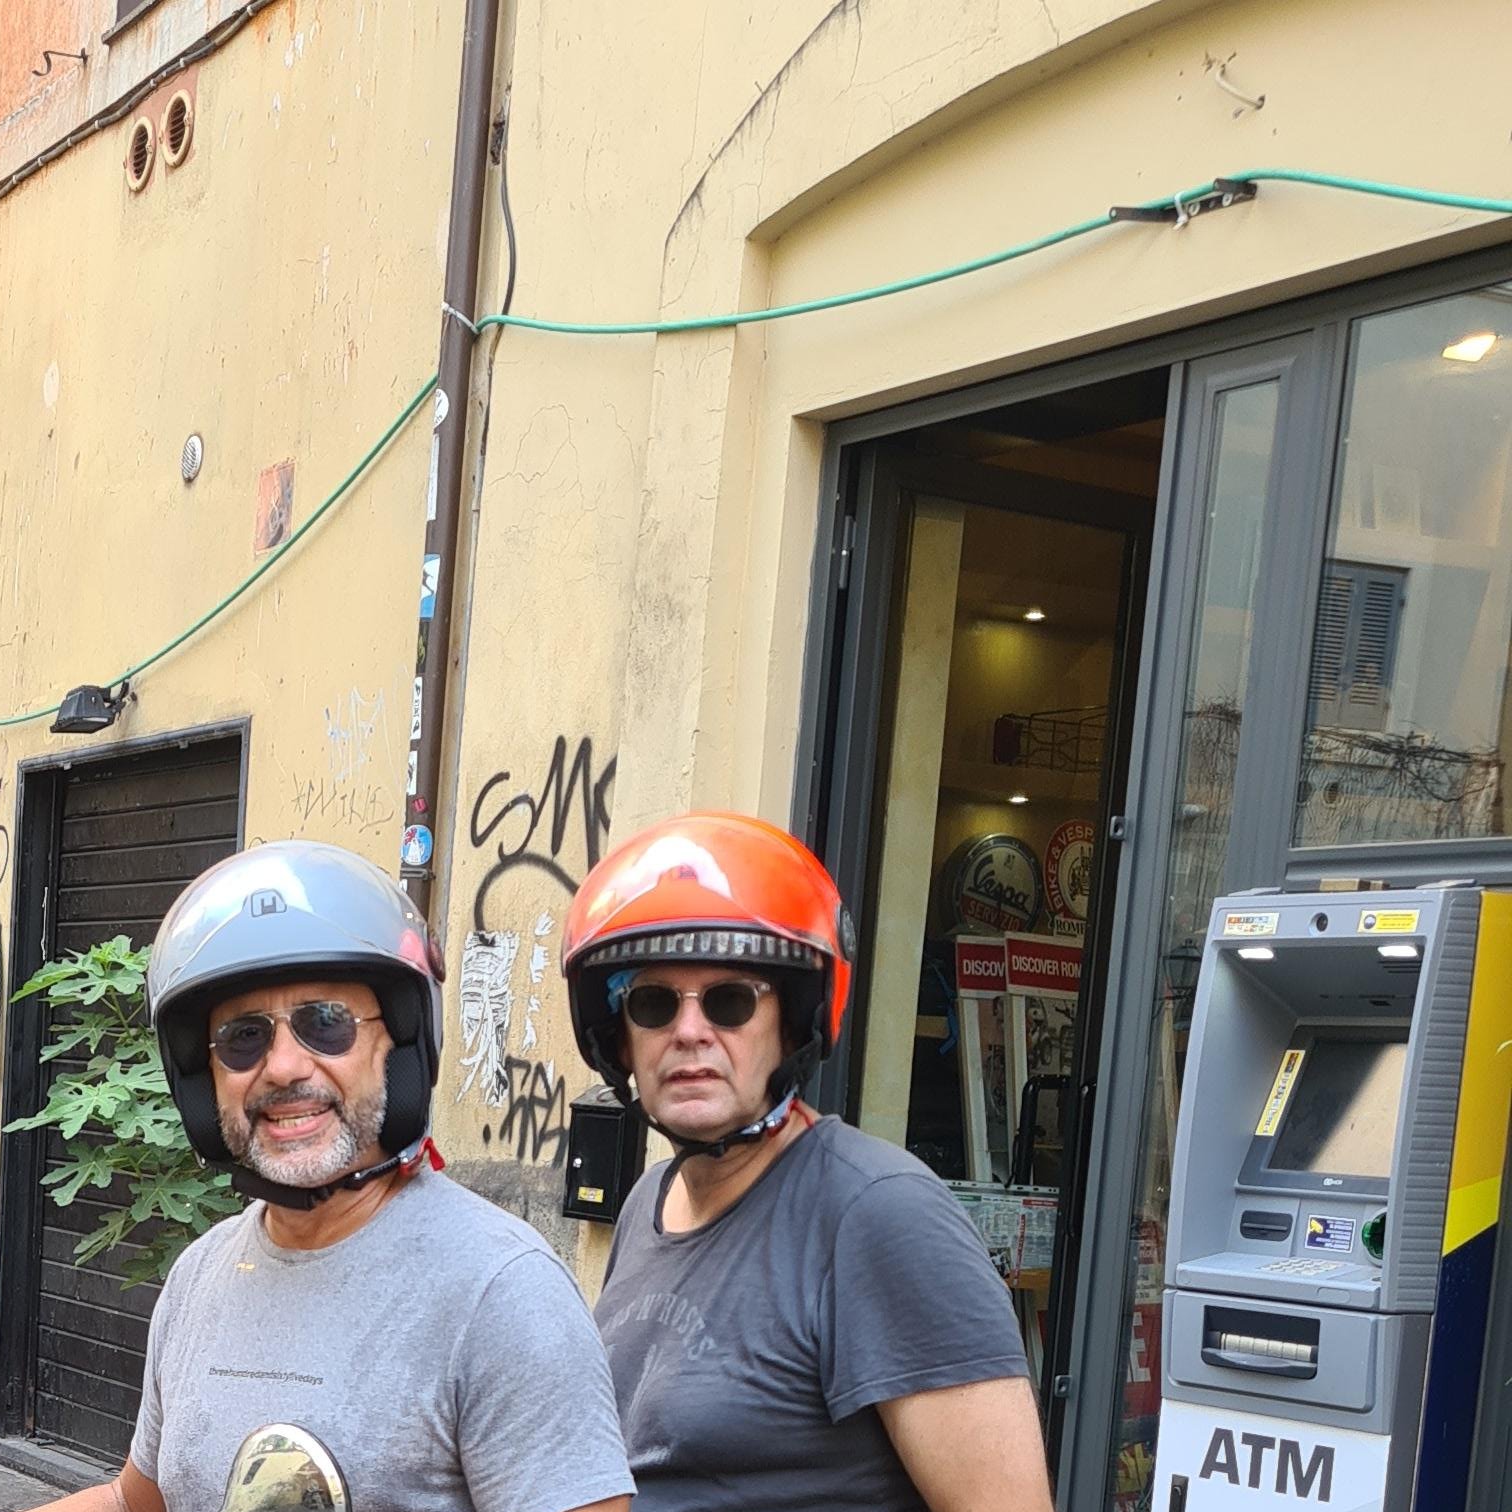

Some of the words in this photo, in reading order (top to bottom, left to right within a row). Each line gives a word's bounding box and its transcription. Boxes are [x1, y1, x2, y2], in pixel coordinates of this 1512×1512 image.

[1048, 864, 1065, 911] BIKE
[1059, 825, 1095, 846] VESP
[967, 900, 1021, 931] SERVZIO
[963, 959, 1005, 978] DISCOV
[1011, 955, 1060, 977] DISCOVER
[1061, 962, 1082, 979] ROM
[1198, 1427, 1336, 1504] ATM
